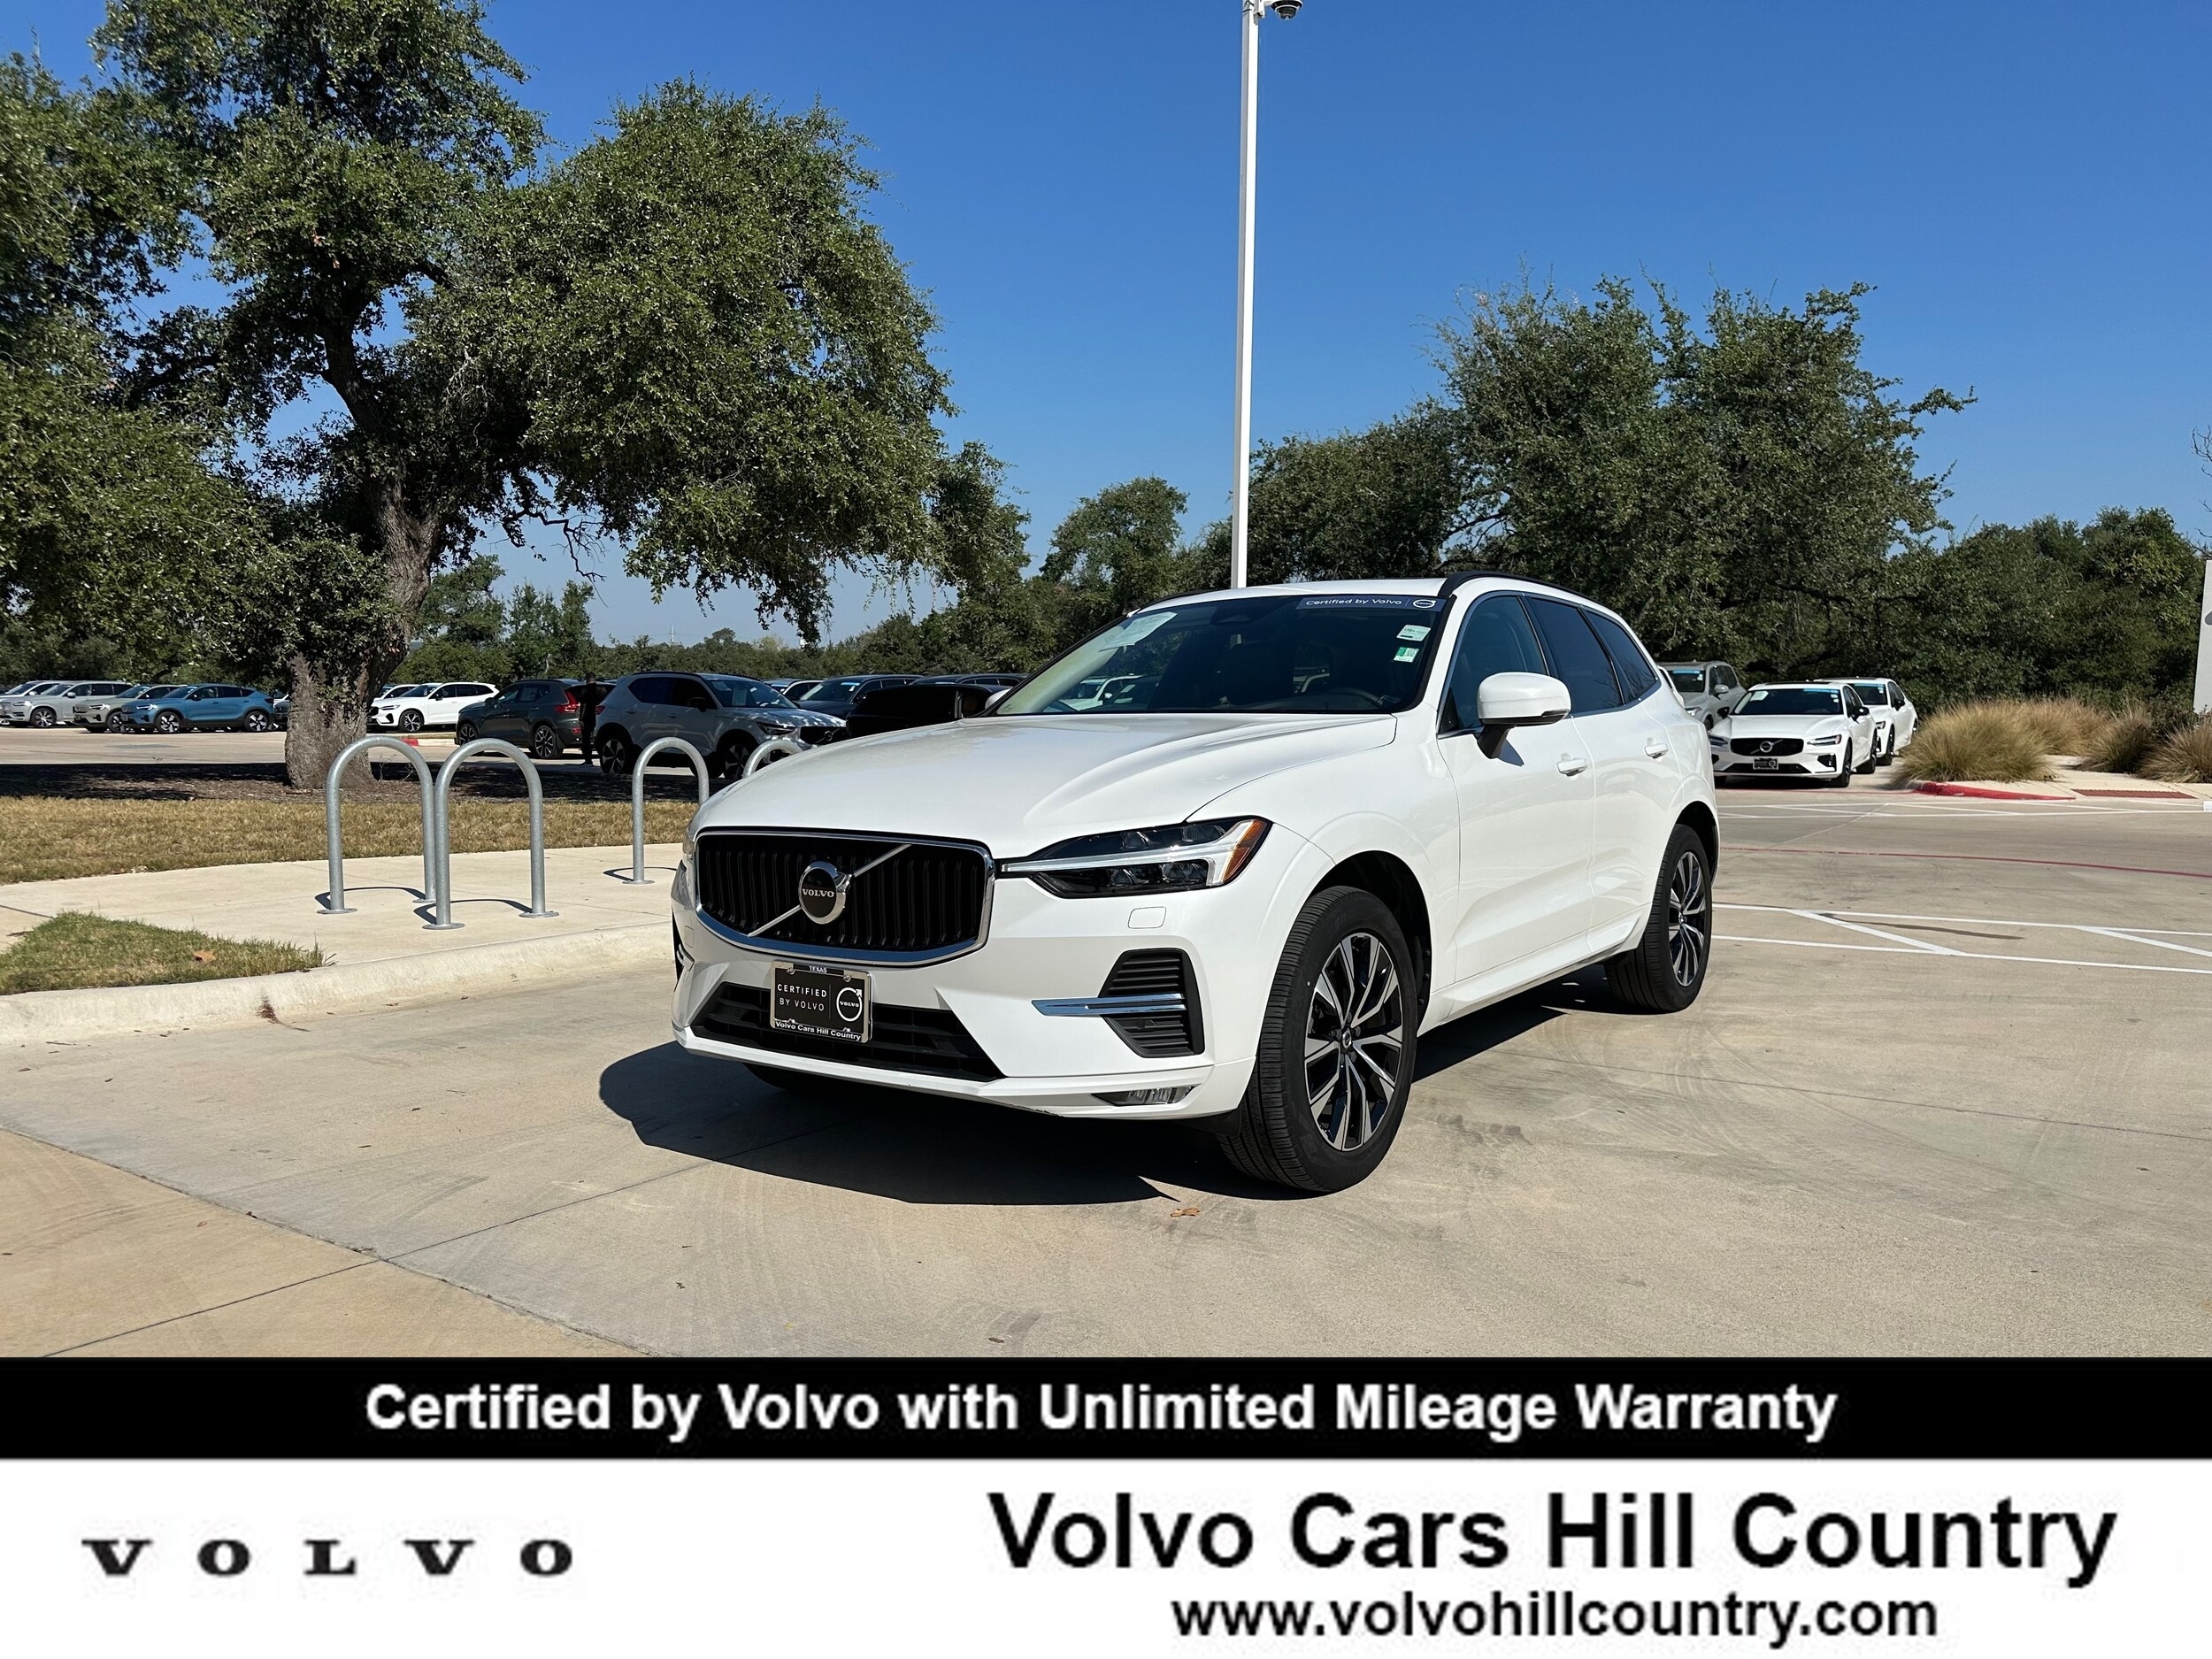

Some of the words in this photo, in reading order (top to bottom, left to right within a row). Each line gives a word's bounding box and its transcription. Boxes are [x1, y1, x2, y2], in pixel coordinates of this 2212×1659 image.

[802, 887, 834, 898] VOLVO
[778, 984, 827, 997] CERTIFIED
[795, 1000, 825, 1011] VOLVO
[775, 1021, 795, 1030] Volvo
[797, 1023, 815, 1033] Cars
[830, 1030, 861, 1041] Country
